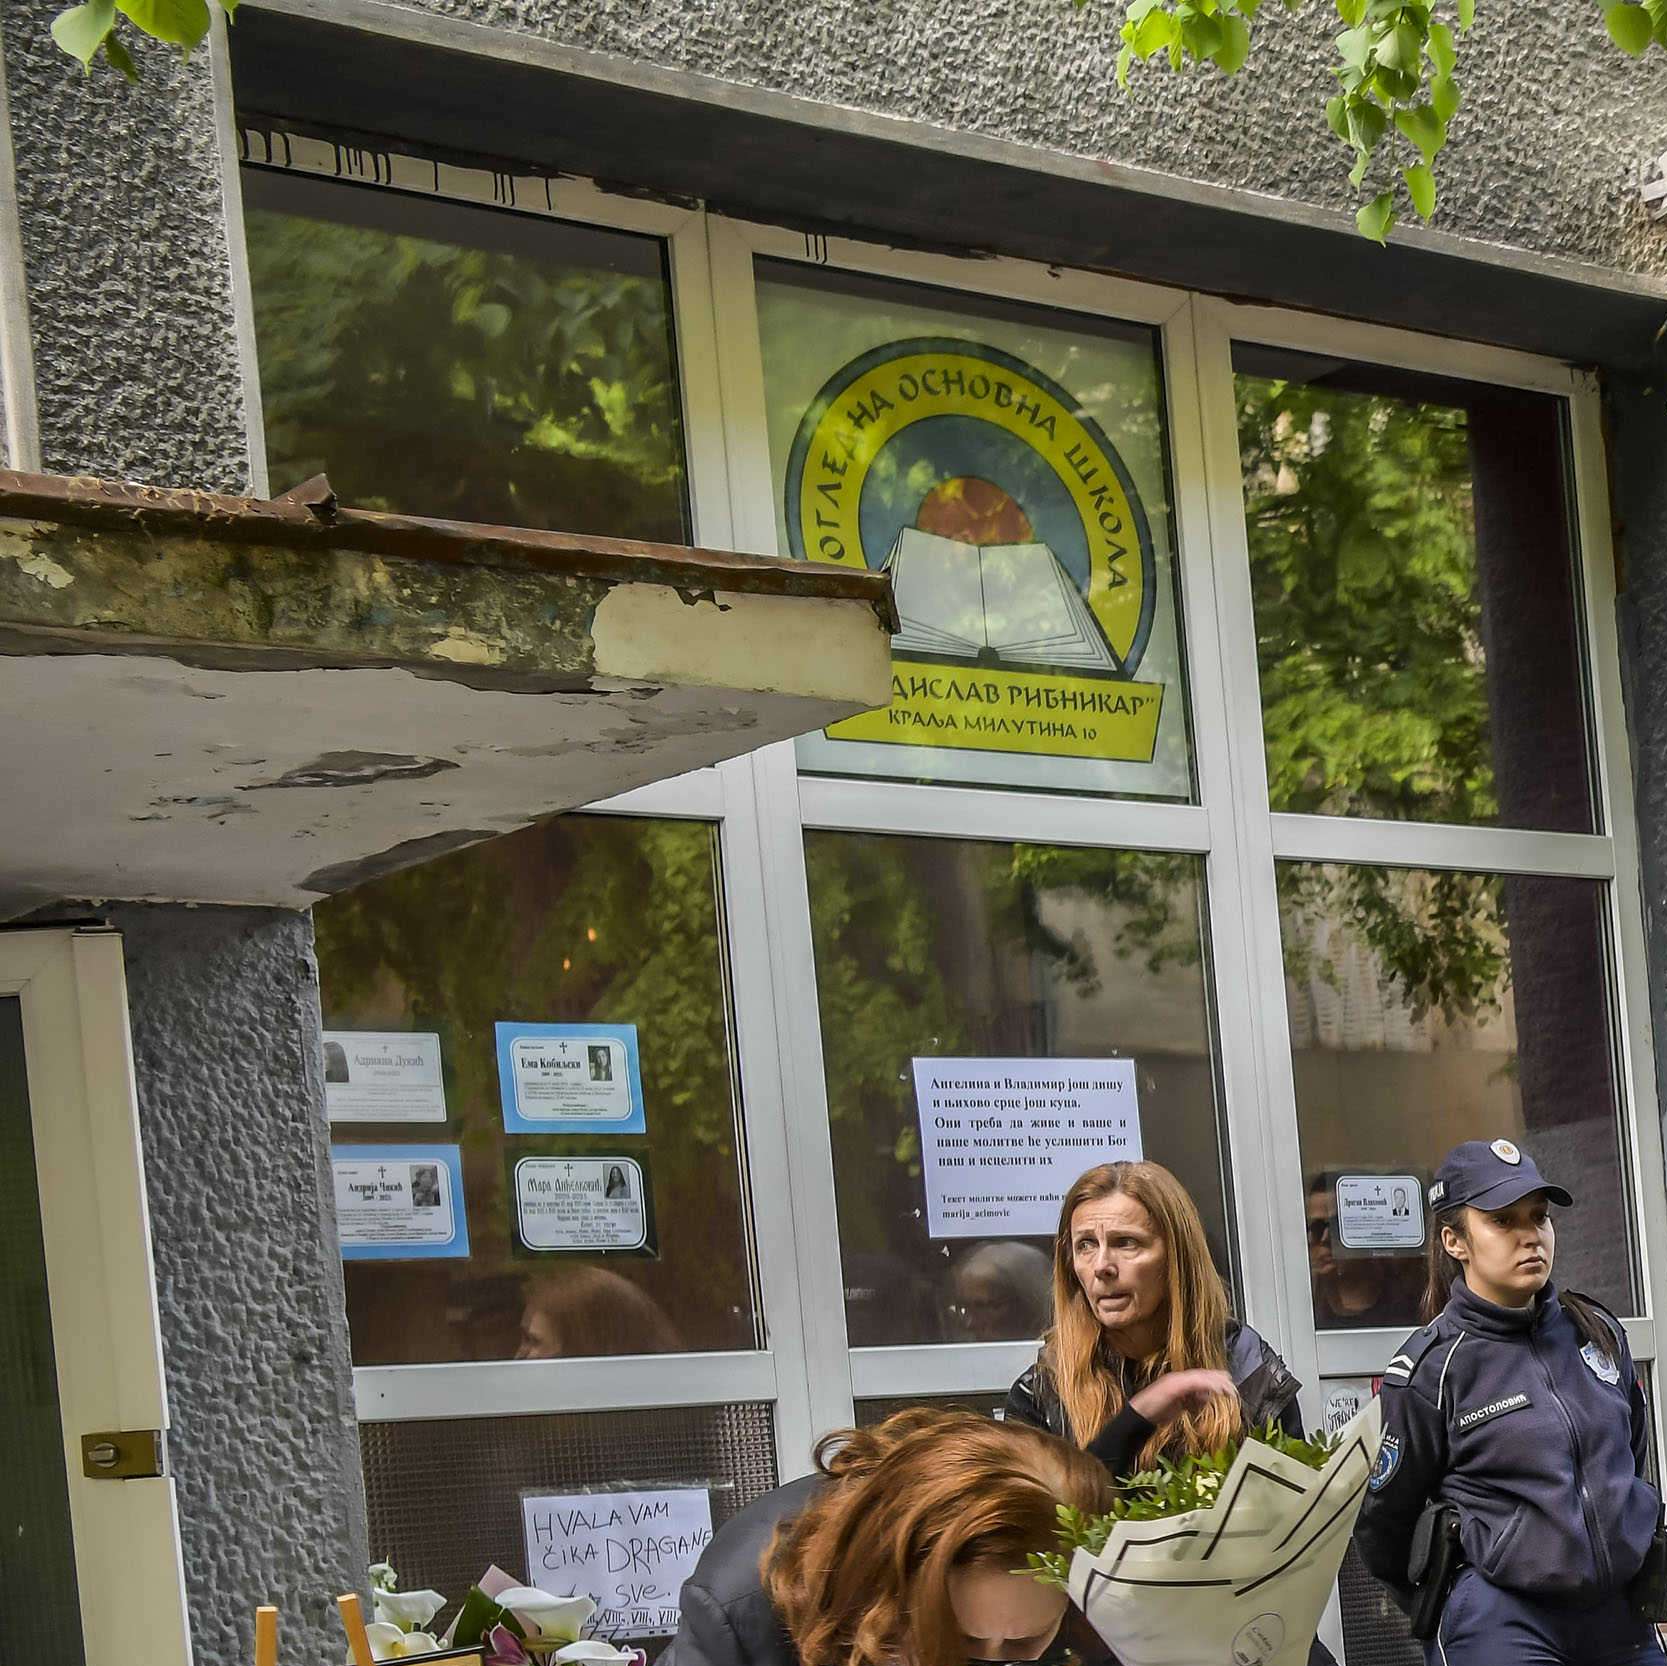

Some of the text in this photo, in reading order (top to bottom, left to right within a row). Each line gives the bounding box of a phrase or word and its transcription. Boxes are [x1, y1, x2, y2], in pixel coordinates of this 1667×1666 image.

[814, 368, 1129, 591] ОГЛЕДНА ОСНОВНА ШКОЛА
[891, 674, 1000, 706] ДИСЛАВ
[888, 708, 958, 733] КРАЉА
[964, 713, 1077, 740] МИЛУТИНА
[521, 1058, 538, 1068] Ема
[931, 1078, 991, 1089] Ангелина
[1004, 1078, 1065, 1092] Владимир
[1067, 1078, 1089, 1092] још
[1092, 1081, 1123, 1092] дишу
[944, 1100, 991, 1108] њихово
[1023, 1096, 1046, 1110] још
[935, 1117, 961, 1128] Они
[969, 1117, 1003, 1131] треба
[1010, 1120, 1023, 1129] да
[1031, 1120, 1060, 1128] живе
[1082, 1119, 1112, 1128] ваше
[1119, 1119, 1127, 1127] и
[936, 1135, 1128, 1149] наше молитве ће услишити Бог
[938, 1156, 1053, 1167] наш и исцелити их
[1460, 1394, 1527, 1427] АПОСТОЛОВИЋ
[533, 1501, 669, 1543] HVALA VAM
